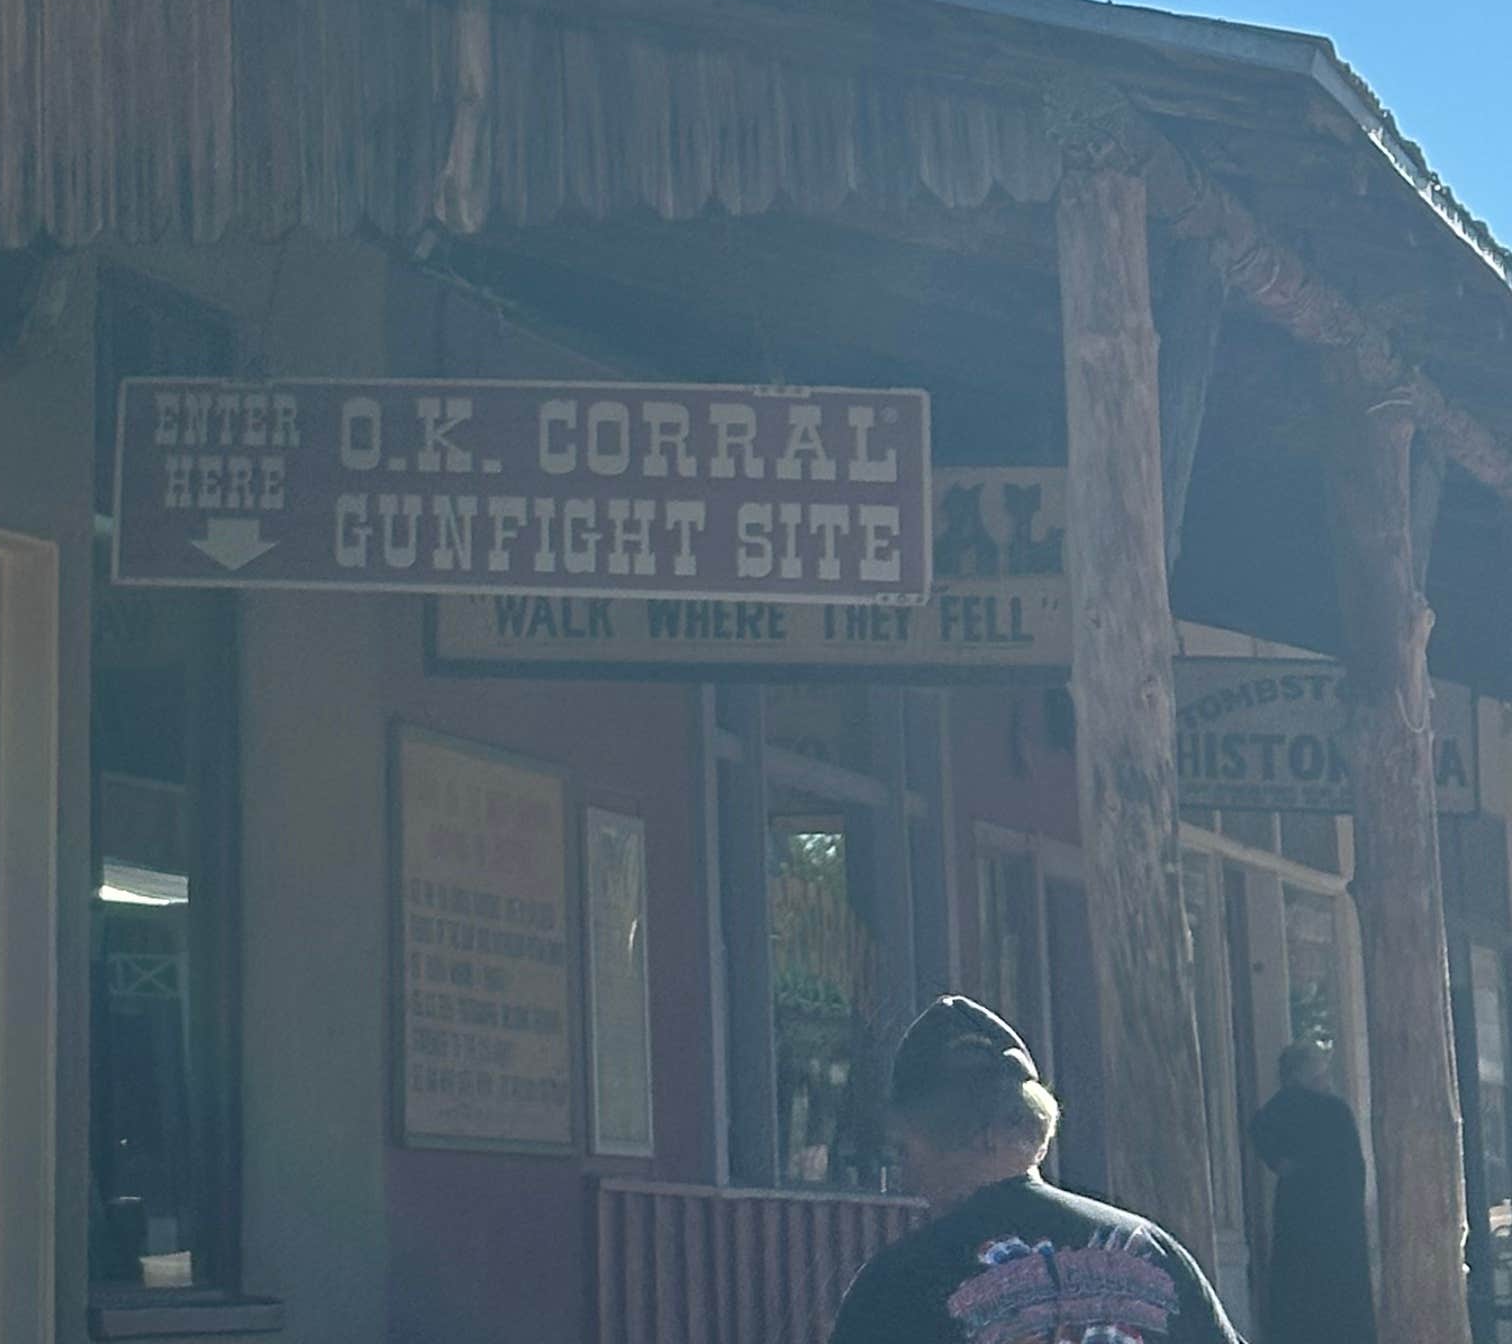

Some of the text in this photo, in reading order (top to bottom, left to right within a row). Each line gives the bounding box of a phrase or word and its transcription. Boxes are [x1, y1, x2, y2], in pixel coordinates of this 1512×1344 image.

[153, 392, 300, 448] ENTER
[339, 396, 899, 482] O.K. CORRAL
[164, 456, 286, 511] HERE
[333, 493, 707, 578] GUNFIGHT
[735, 501, 901, 583] SITE
[646, 597, 787, 641] WHERE
[1176, 674, 1338, 729] TOMBST
